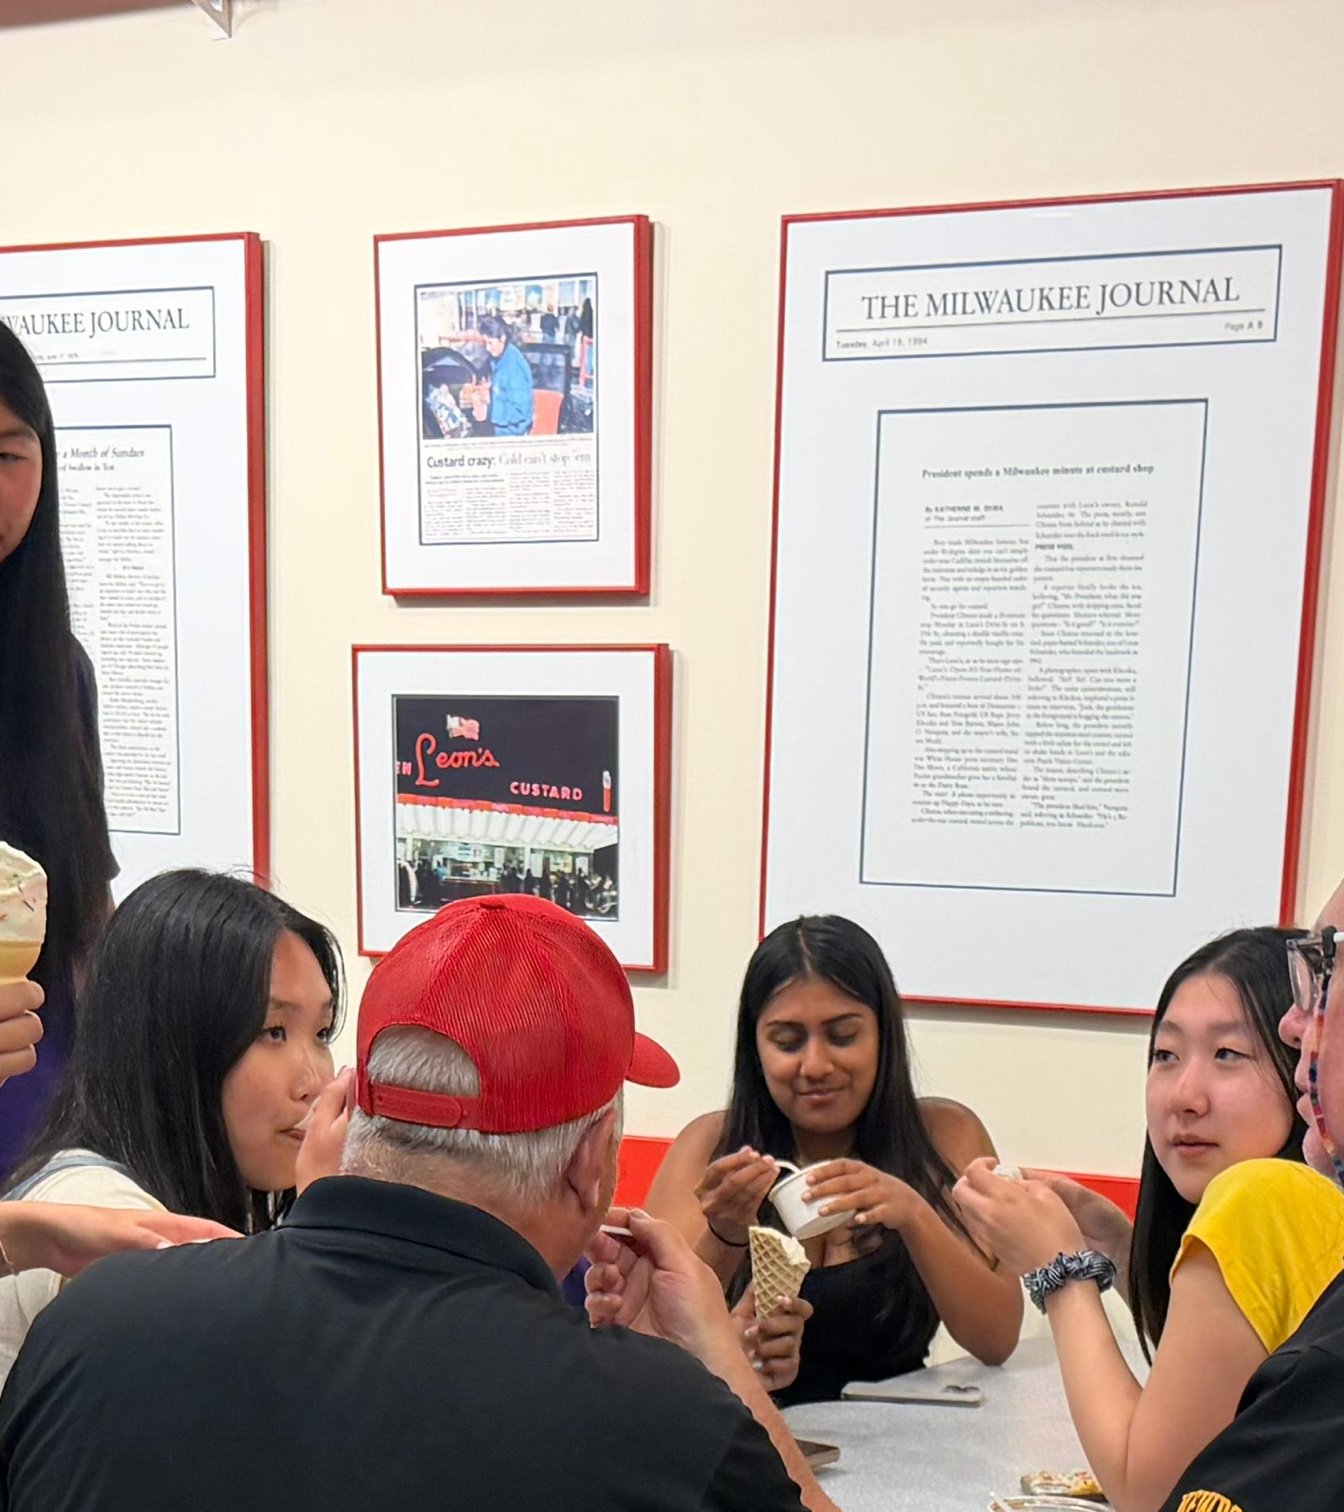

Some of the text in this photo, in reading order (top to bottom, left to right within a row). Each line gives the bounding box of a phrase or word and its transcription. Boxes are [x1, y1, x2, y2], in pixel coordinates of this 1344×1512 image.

[861, 277, 1240, 320] THE MILWAUKEE JOURNAL
[1, 308, 190, 338] WAUKEE JOURNAL
[426, 455, 466, 469] Custard
[467, 456, 497, 470] crazy:
[922, 468, 963, 479] President
[964, 467, 993, 480] spends
[1003, 466, 1050, 476] Milwaukee
[1097, 463, 1131, 474] custard
[1133, 463, 1154, 475] shop
[415, 732, 501, 788] Leon's
[509, 780, 583, 801] CUSTARD
